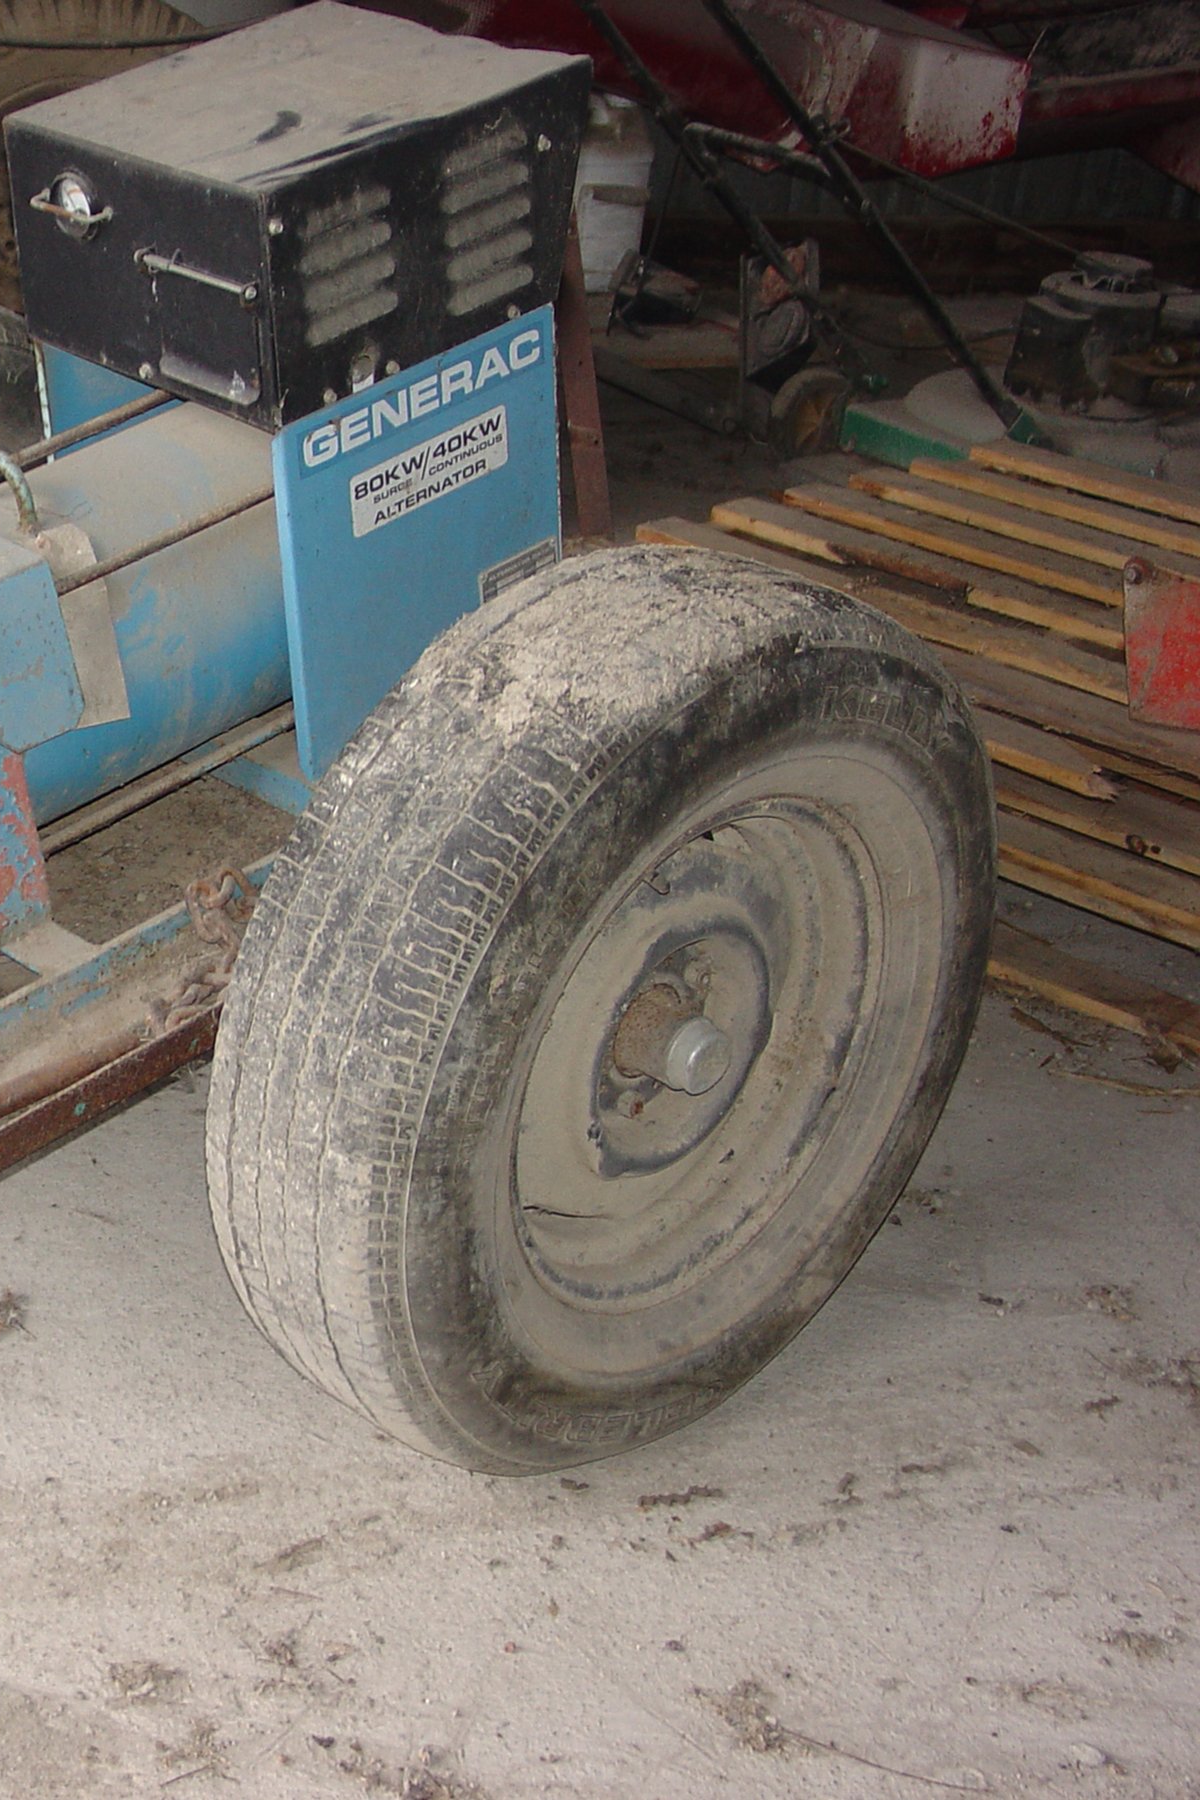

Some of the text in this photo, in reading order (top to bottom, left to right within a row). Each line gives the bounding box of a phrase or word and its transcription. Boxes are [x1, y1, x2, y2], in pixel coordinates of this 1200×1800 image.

[303, 329, 541, 468] GENERAC
[429, 433, 503, 476] CONTINUOUS
[374, 458, 487, 526] ALTERNATOR
